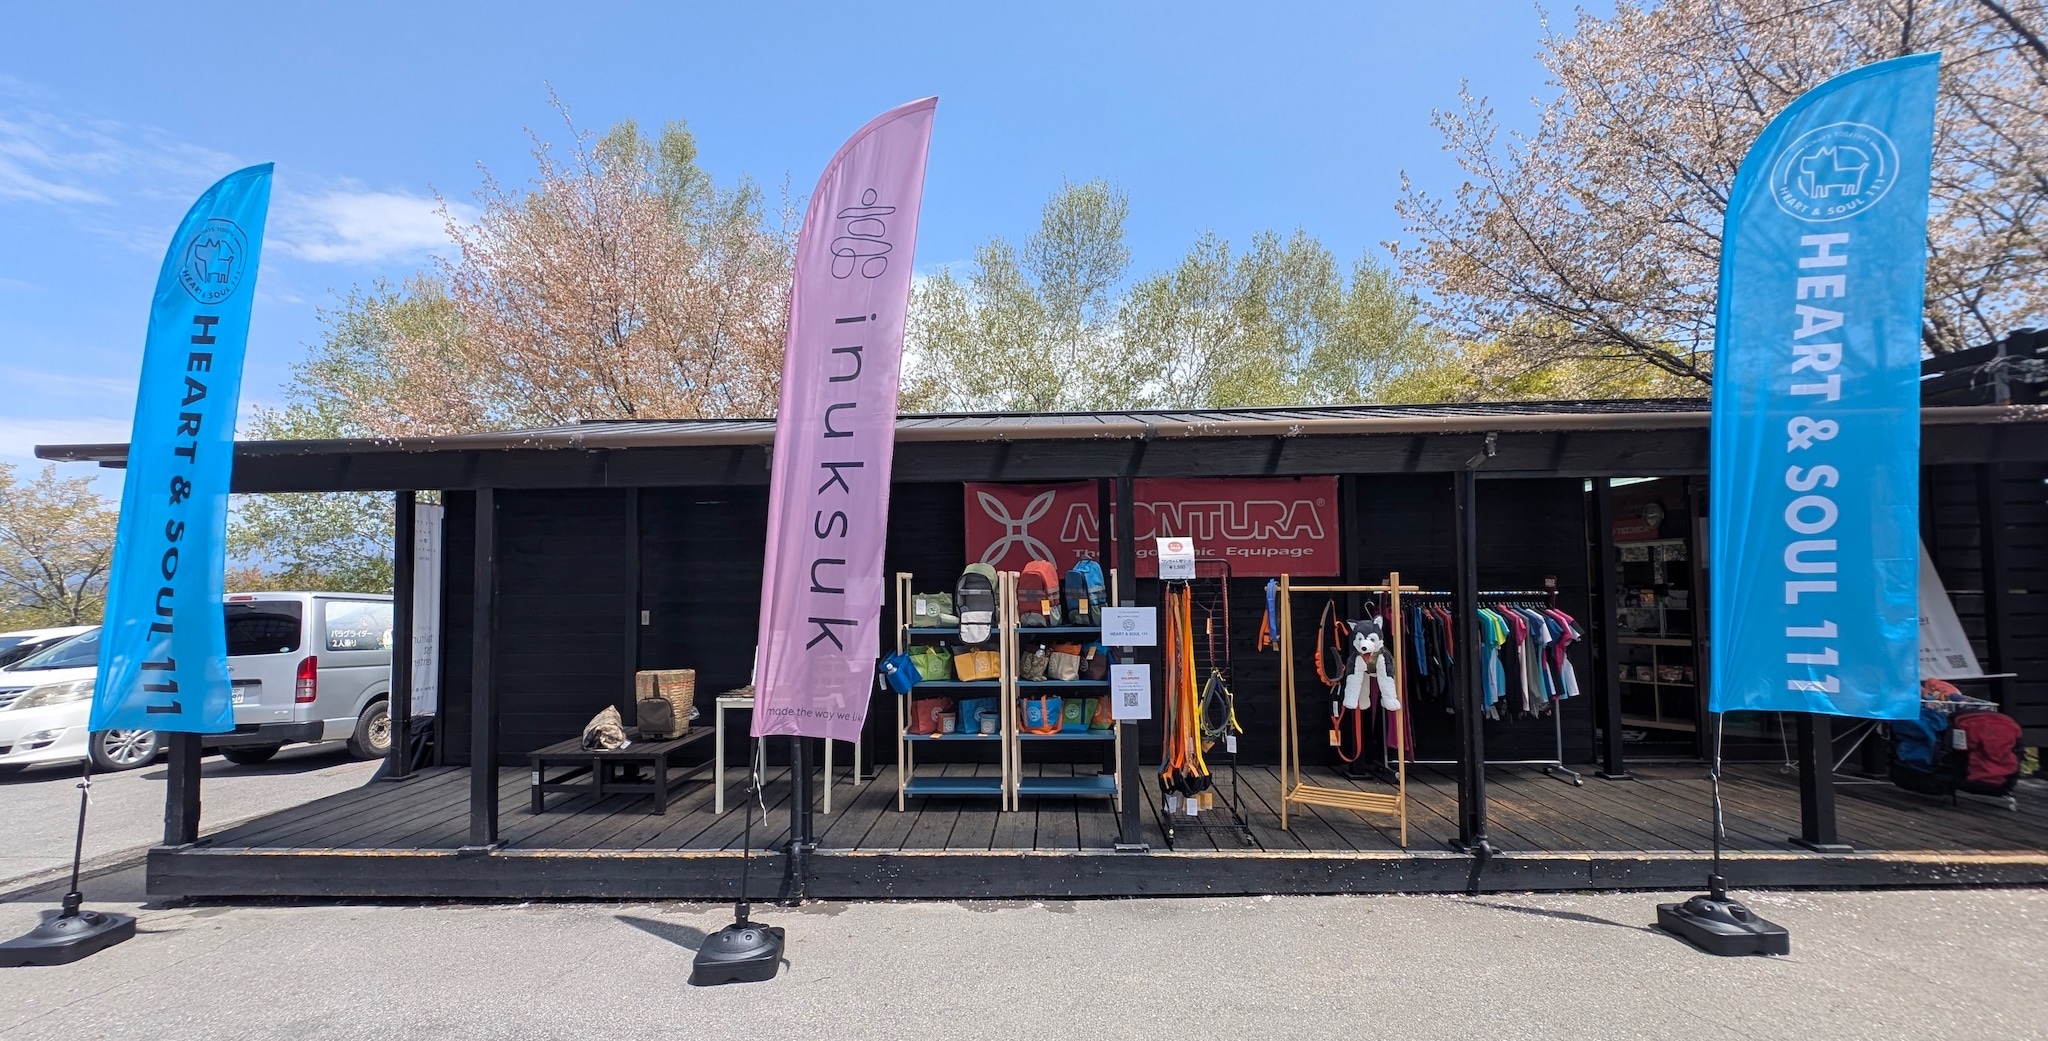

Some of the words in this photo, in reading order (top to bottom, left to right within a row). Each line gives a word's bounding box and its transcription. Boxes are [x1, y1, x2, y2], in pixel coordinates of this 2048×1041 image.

[1780, 186, 1809, 212] HEART
[1811, 208, 1820, 216] &
[1827, 198, 1865, 215] SOUL
[208, 286, 230, 299] SOUL
[1790, 231, 1850, 401] HEART
[174, 315, 220, 464] HEART
[1787, 415, 1839, 453] &
[168, 475, 192, 507] &
[806, 313, 877, 651] inuksuk
[1226, 547, 1314, 557] Equipage
[1784, 464, 1840, 605] SOUL
[146, 521, 184, 642] SOUL
[330, 629, 373, 638] パラグライダー
[1785, 619, 1840, 694] 111
[141, 656, 182, 715] 111
[767, 707, 794, 716] made
[796, 707, 813, 718] the
[815, 710, 835, 721] way
[837, 712, 850, 721] we
